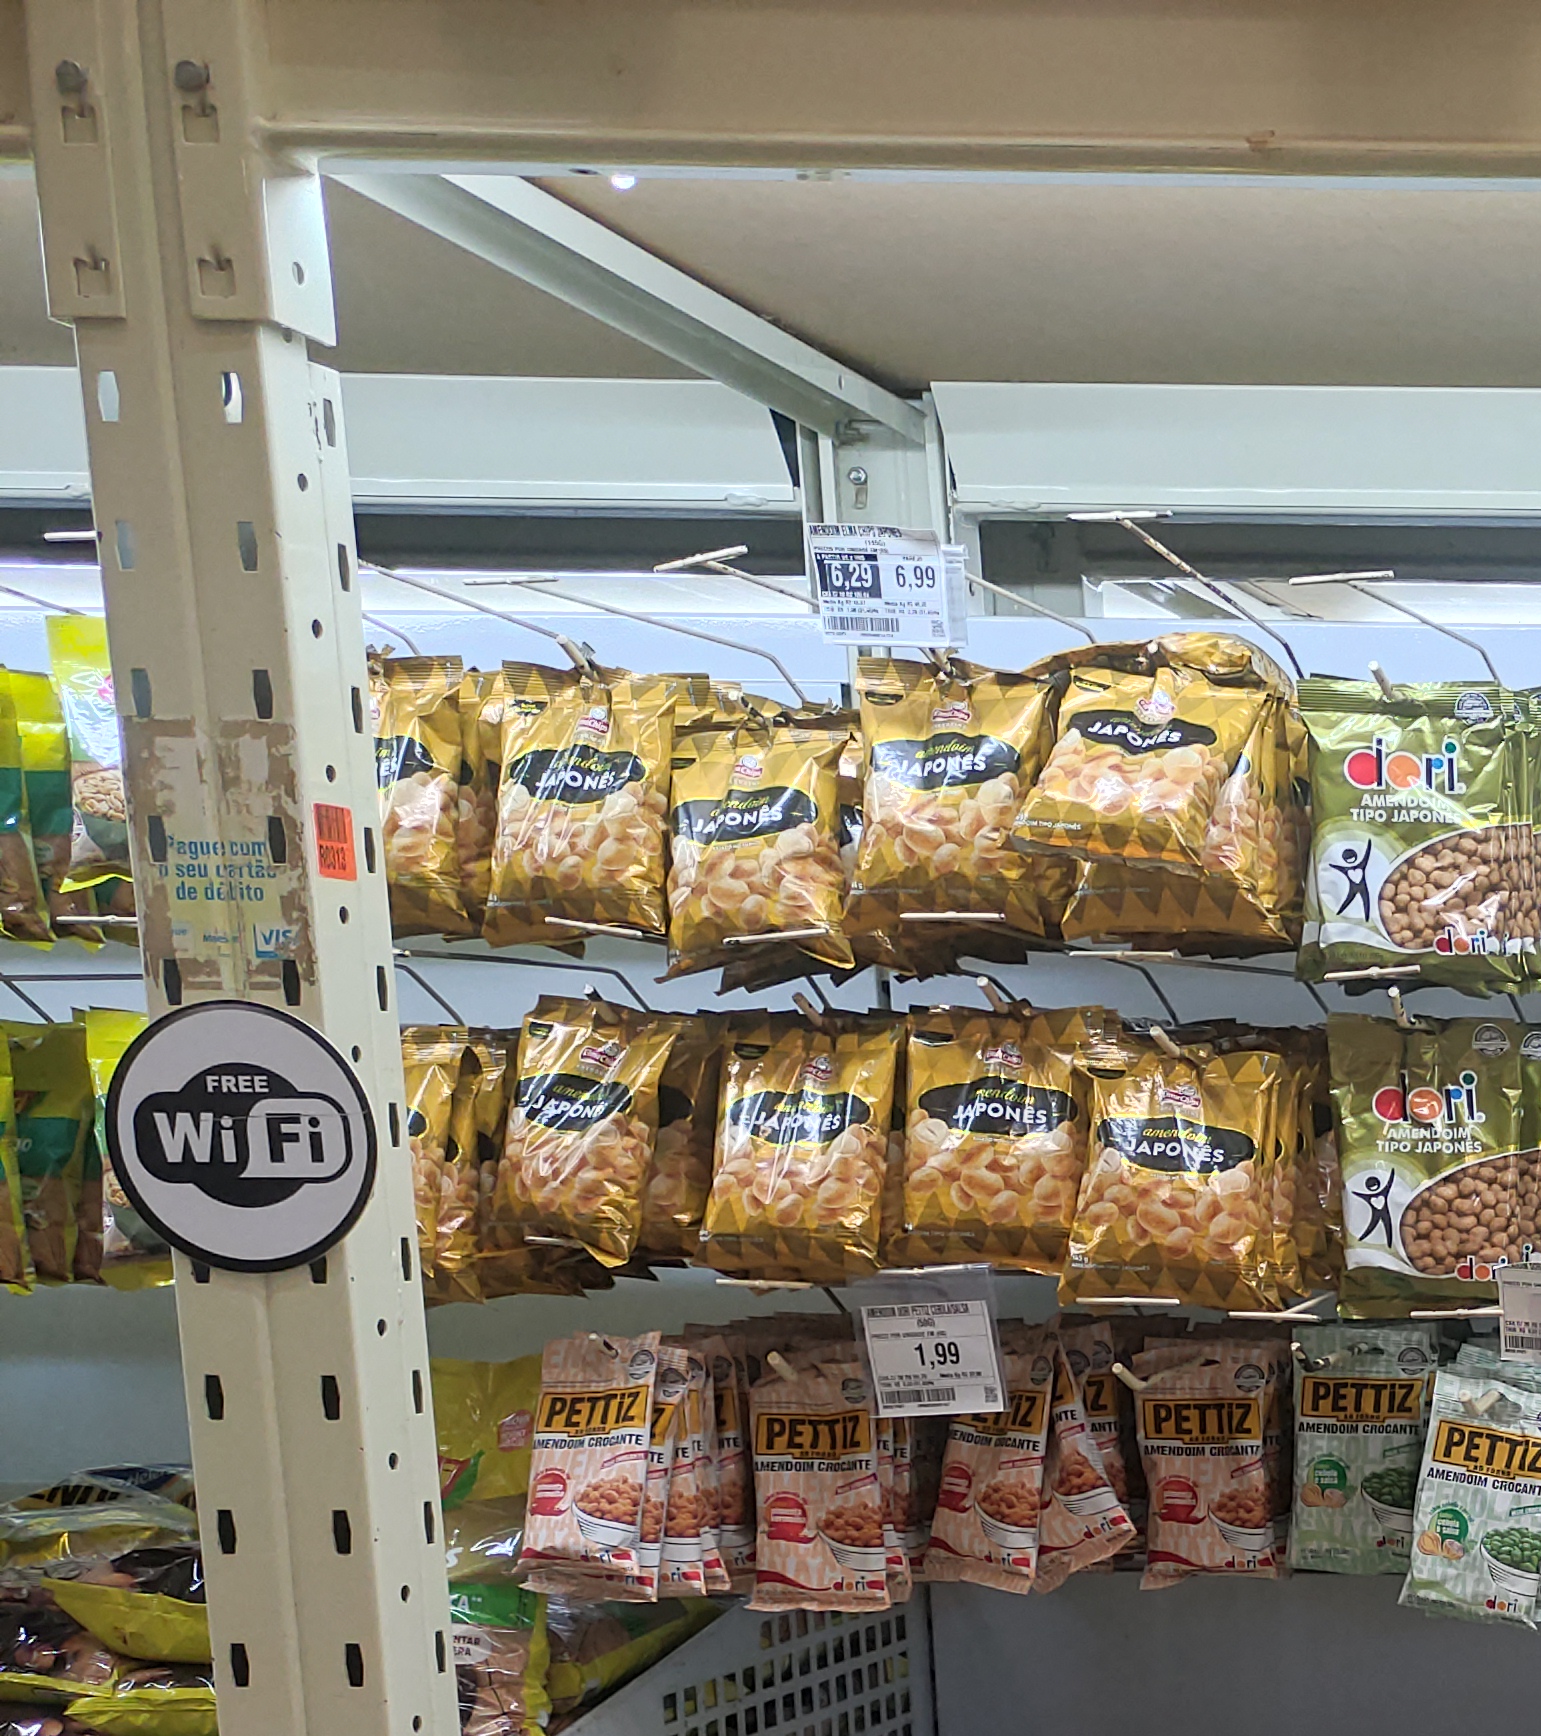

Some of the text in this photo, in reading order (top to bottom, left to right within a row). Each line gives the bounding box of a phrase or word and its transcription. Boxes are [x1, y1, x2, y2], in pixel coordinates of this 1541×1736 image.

[831, 563, 936, 591] 6,29 6,99
[1086, 720, 1183, 750] JAPONÊS
[902, 753, 988, 777] JAPONÊS
[1344, 735, 1458, 794] dori
[692, 805, 783, 836] JAPONÊS
[176, 864, 208, 878] seu
[176, 882, 197, 900] de
[261, 929, 300, 946] VIS
[205, 1075, 270, 1094] FREE
[1372, 1070, 1477, 1124] dori
[952, 1101, 1048, 1125] JAPONÊS
[152, 1112, 325, 1164] WiFi
[1387, 1127, 1472, 1140] AMENDOIM
[1124, 1139, 1226, 1164] JAPONÊS
[1376, 1140, 1410, 1153] TIPO
[914, 1342, 960, 1370] 1,99
[754, 1460, 872, 1472] AMENDOIM CROCANTE
[1426, 1466, 1489, 1488] AMENDOIM
